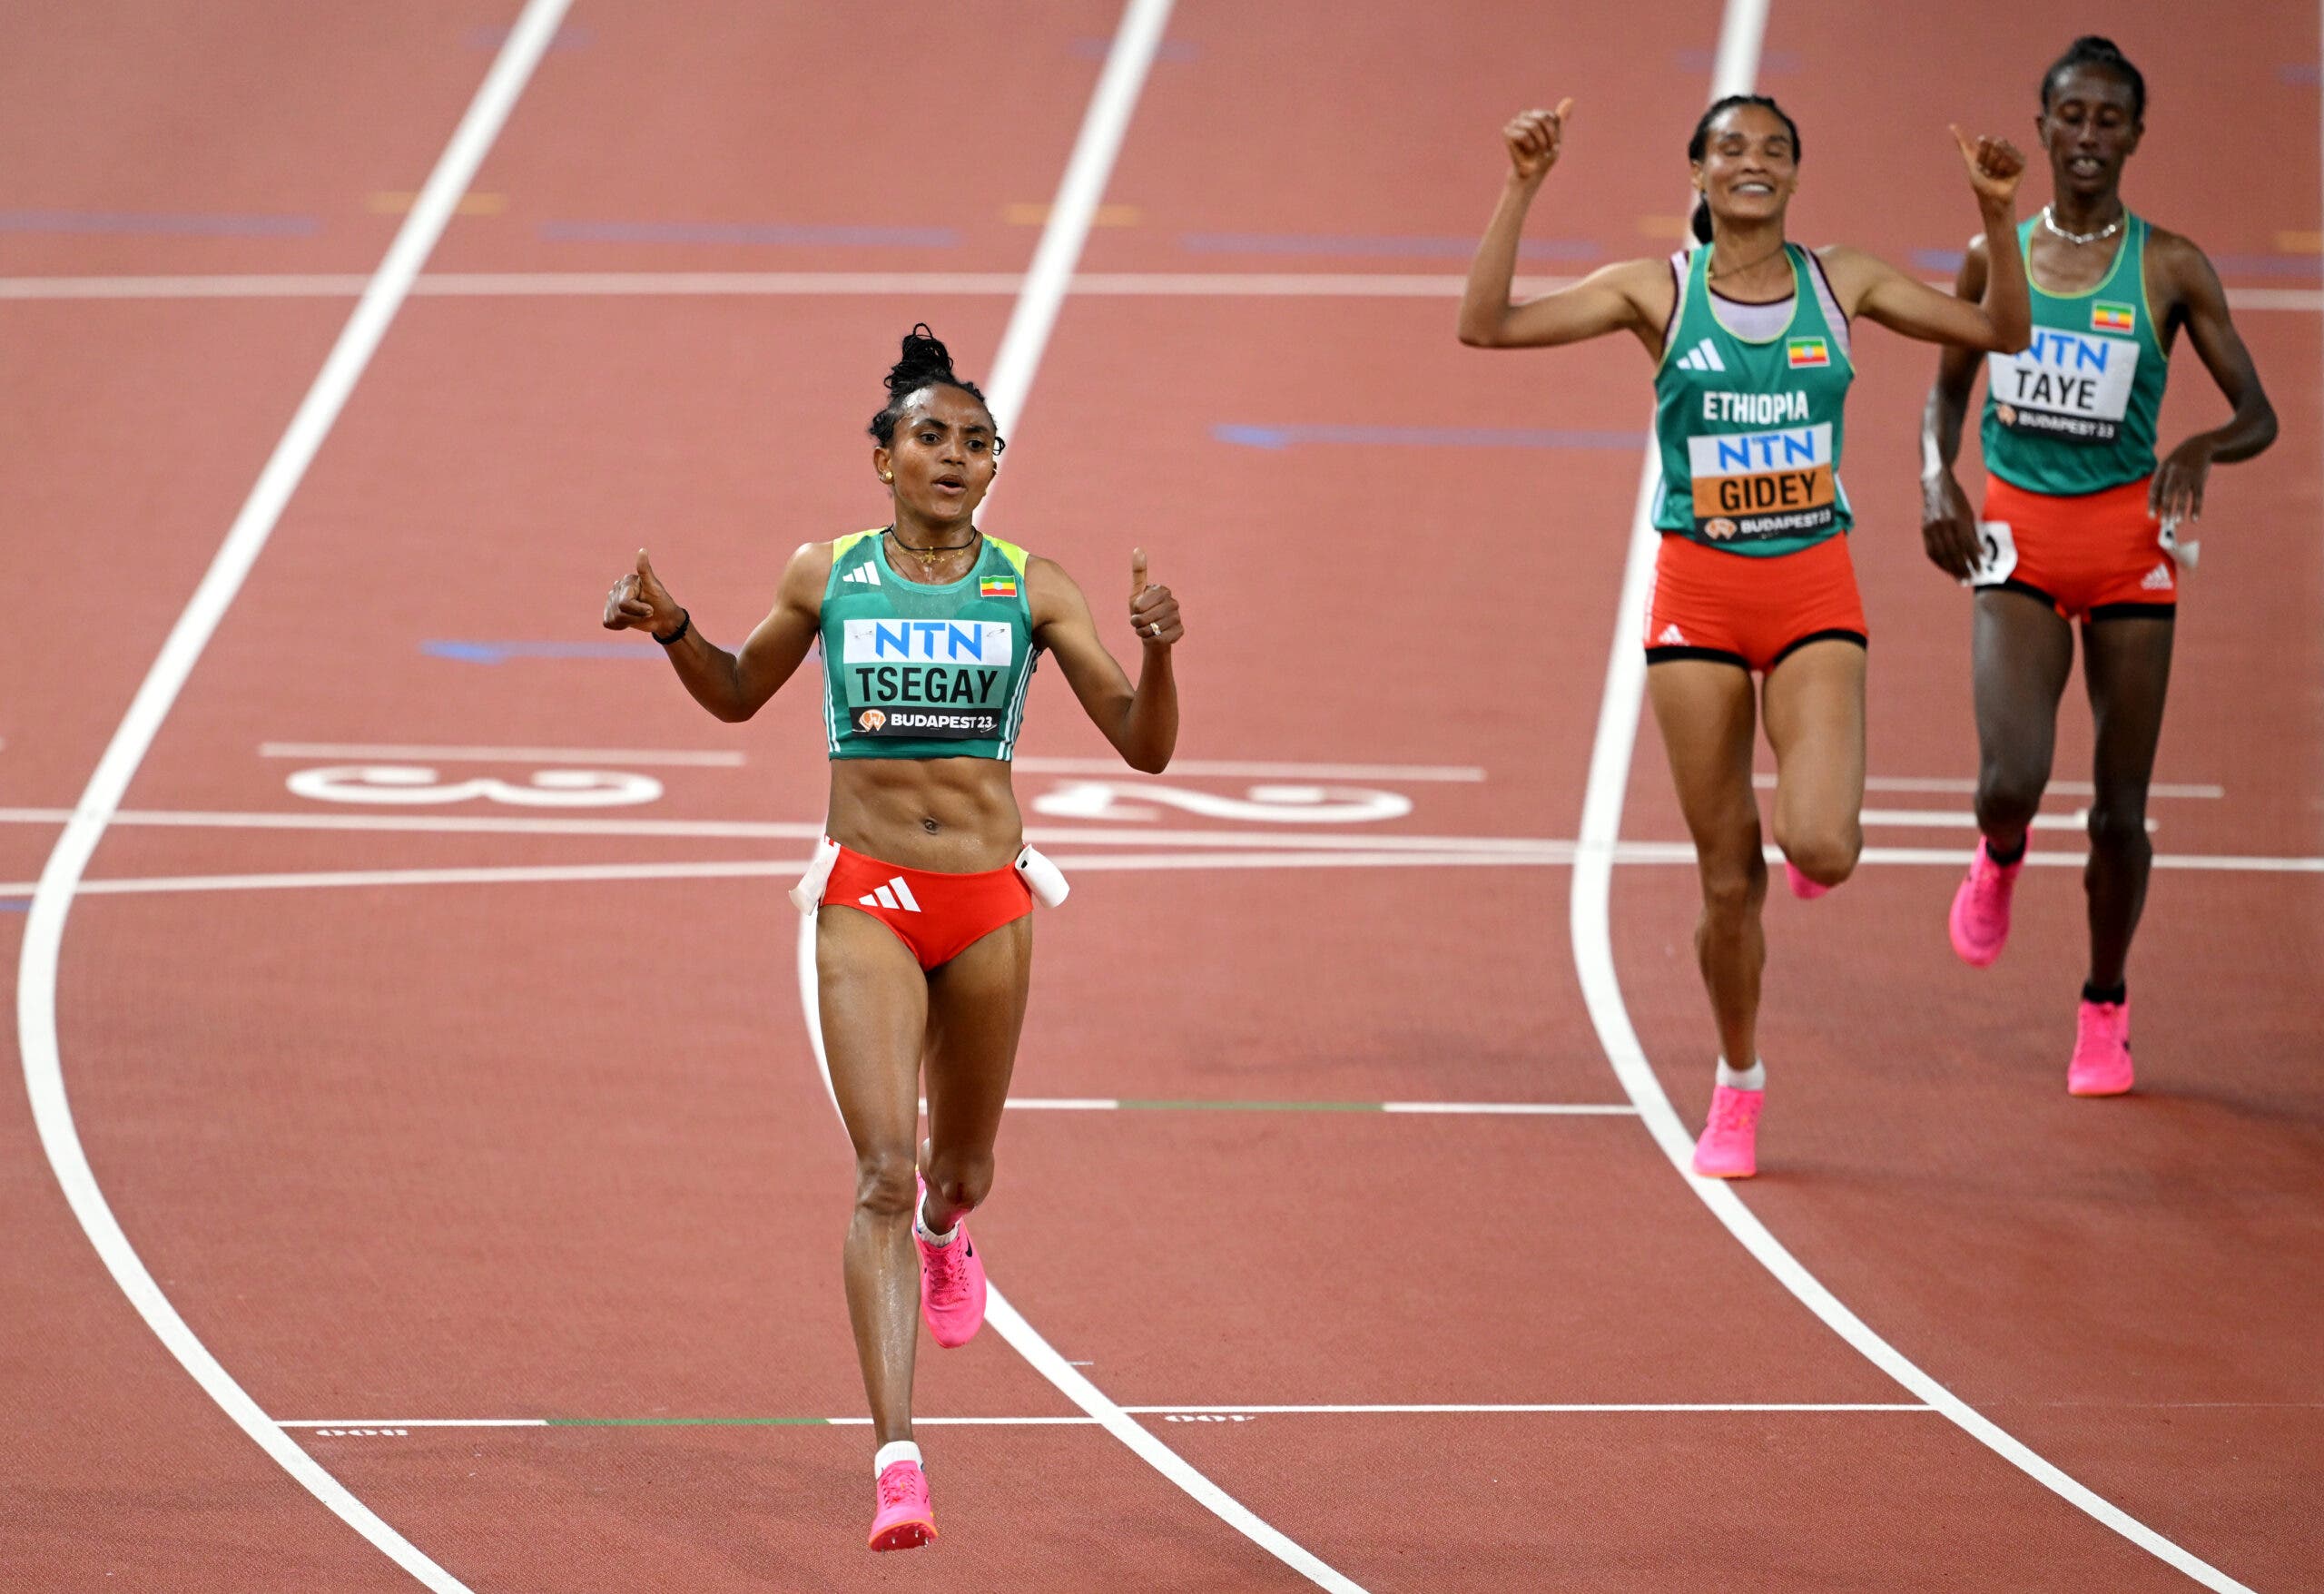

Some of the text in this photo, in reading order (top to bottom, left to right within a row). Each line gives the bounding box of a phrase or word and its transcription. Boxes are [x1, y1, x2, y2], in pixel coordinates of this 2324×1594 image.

[1703, 390, 1810, 425] ETHIOPIA
[2015, 368, 2097, 410] TAYE
[1718, 429, 1816, 471] NTN
[1719, 472, 1817, 512] GIDEY
[875, 621, 983, 662] NTN
[855, 667, 998, 704] TSEGAY
